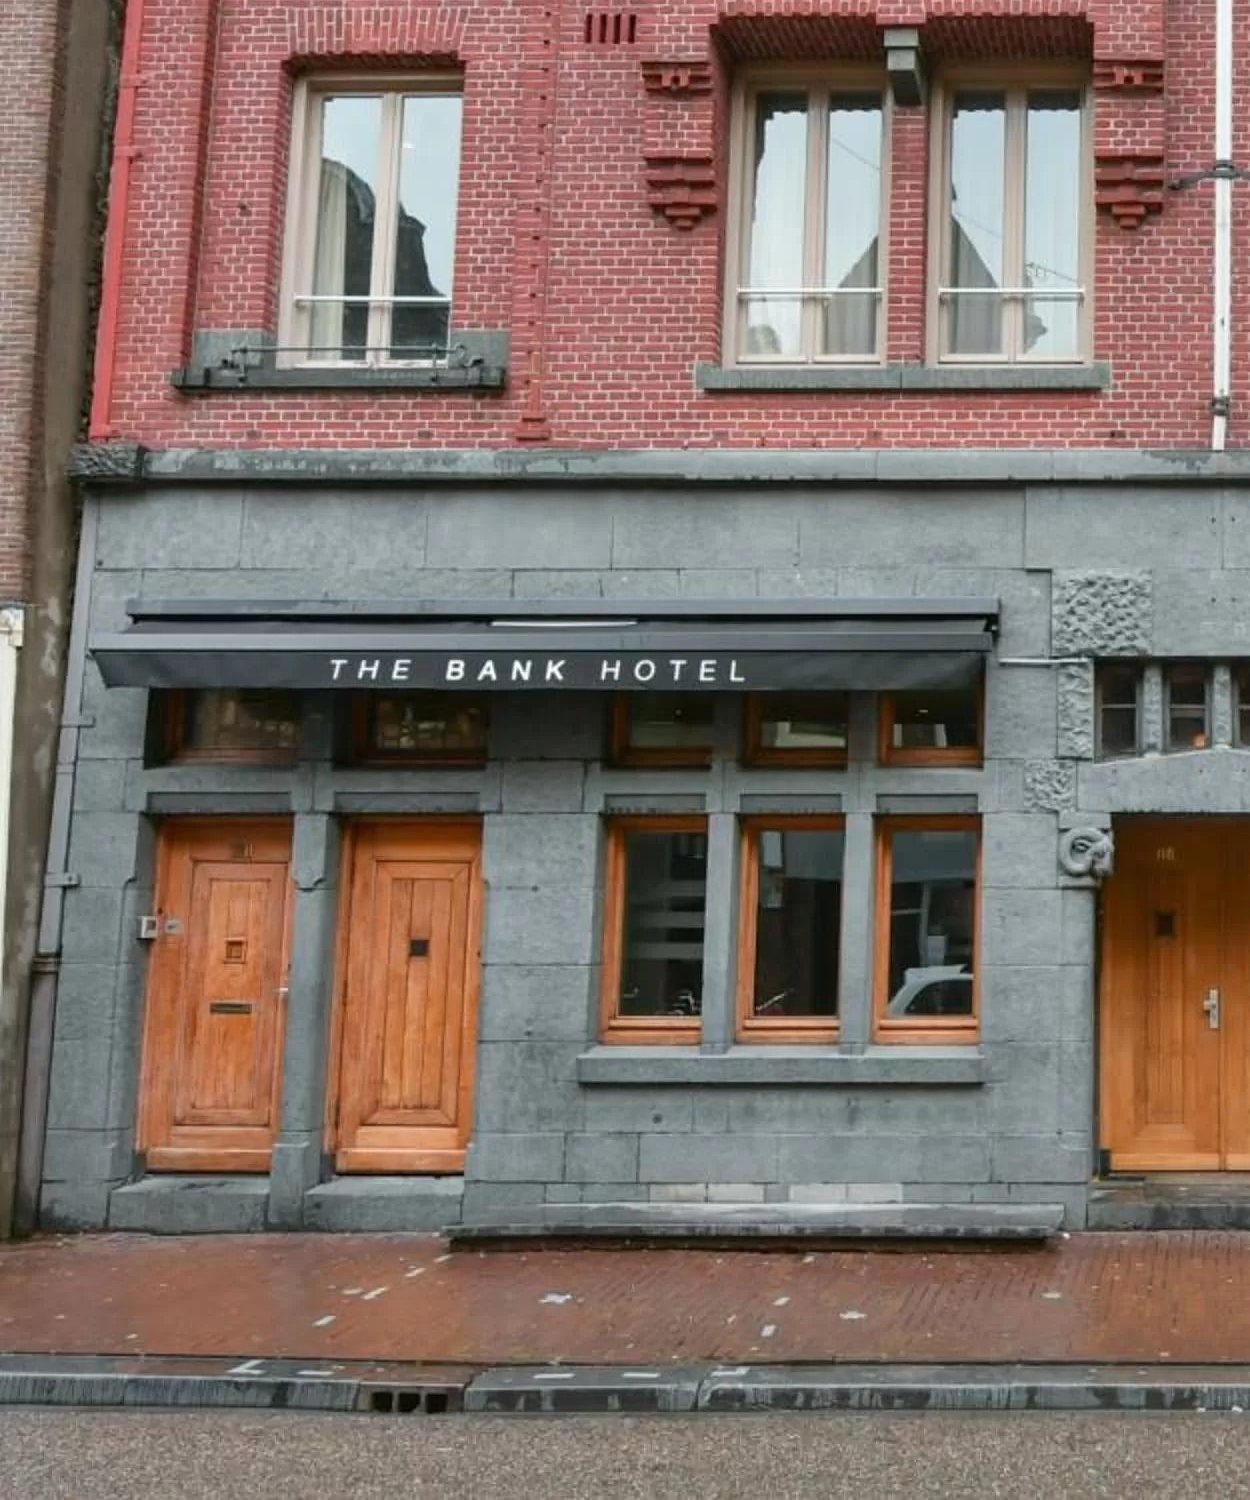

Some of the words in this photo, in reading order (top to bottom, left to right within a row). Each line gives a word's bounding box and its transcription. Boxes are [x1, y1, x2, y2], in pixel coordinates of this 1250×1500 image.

[330, 658, 412, 680] THE
[444, 658, 567, 681] BANK
[600, 658, 746, 682] HOTEL
